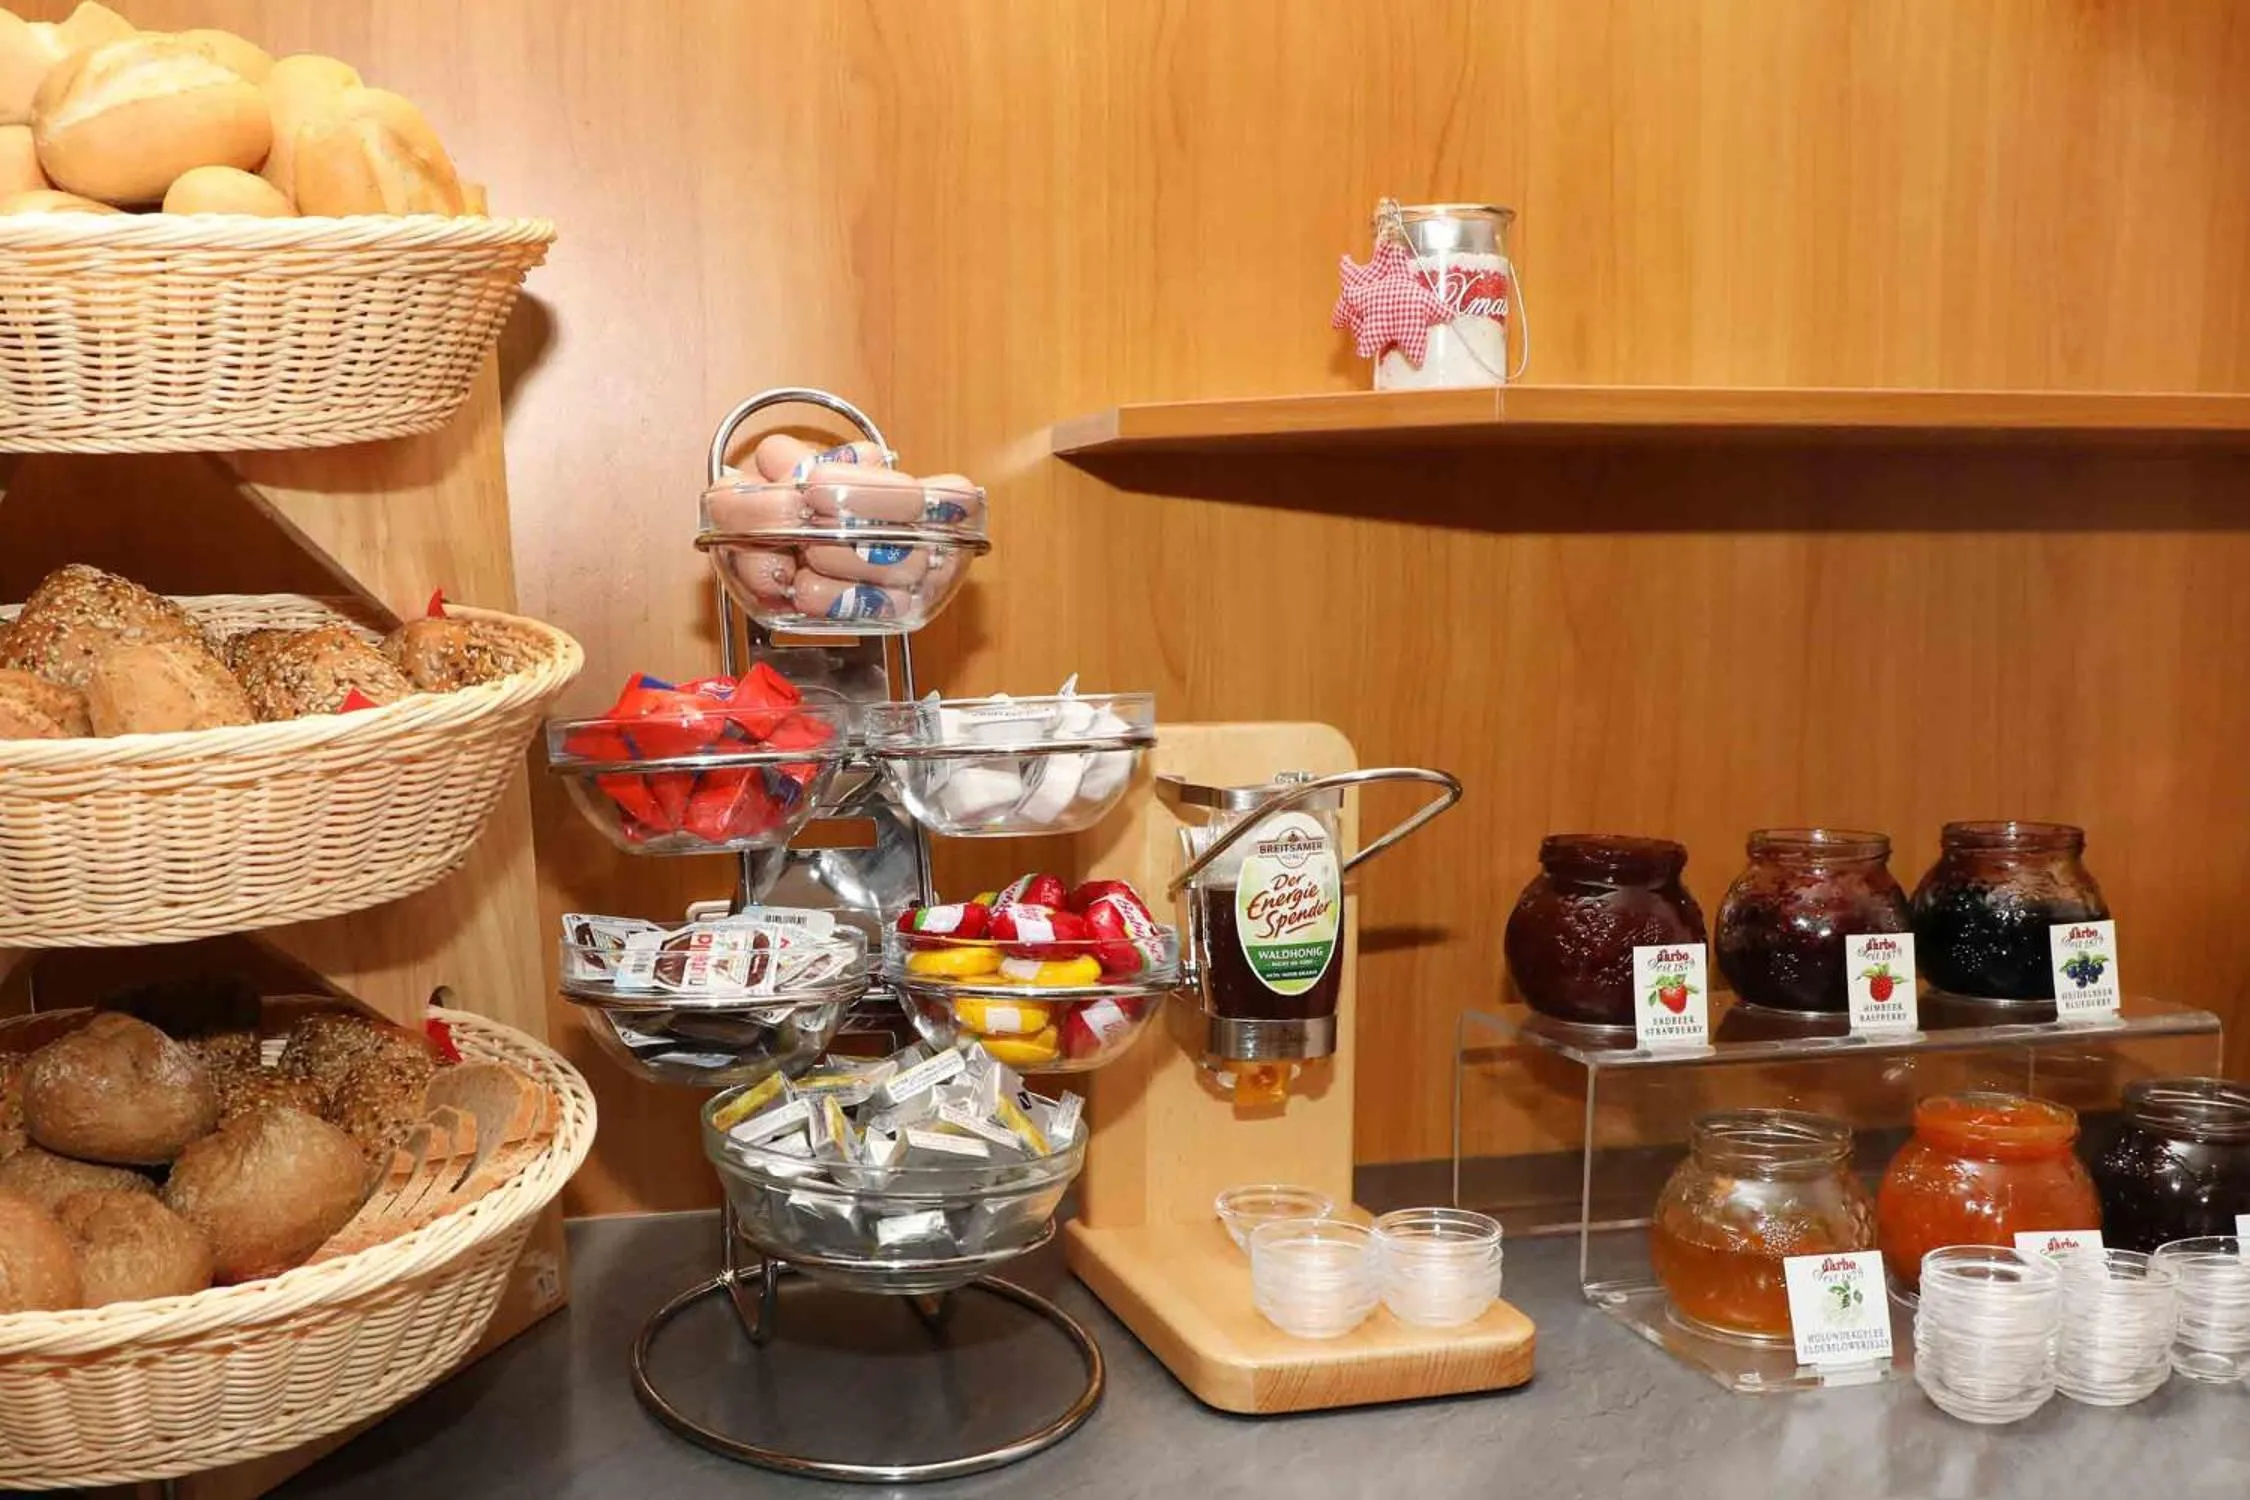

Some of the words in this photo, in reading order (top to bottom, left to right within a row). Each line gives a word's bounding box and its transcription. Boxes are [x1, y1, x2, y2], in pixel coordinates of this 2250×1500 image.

[1259, 842, 1323, 854] BREITSAMER
[1271, 873, 1306, 891] Der
[1247, 881, 1319, 920] Energie
[1255, 899, 1332, 939] Spender
[1258, 946, 1324, 960] WALDHONIG
[1864, 1003, 1903, 1012] HIMBEER
[1653, 1015, 1695, 1026] ERDBEER
[1860, 1012, 1907, 1021] RASPBERRY
[1645, 1025, 1703, 1036] STRAWBERRY
